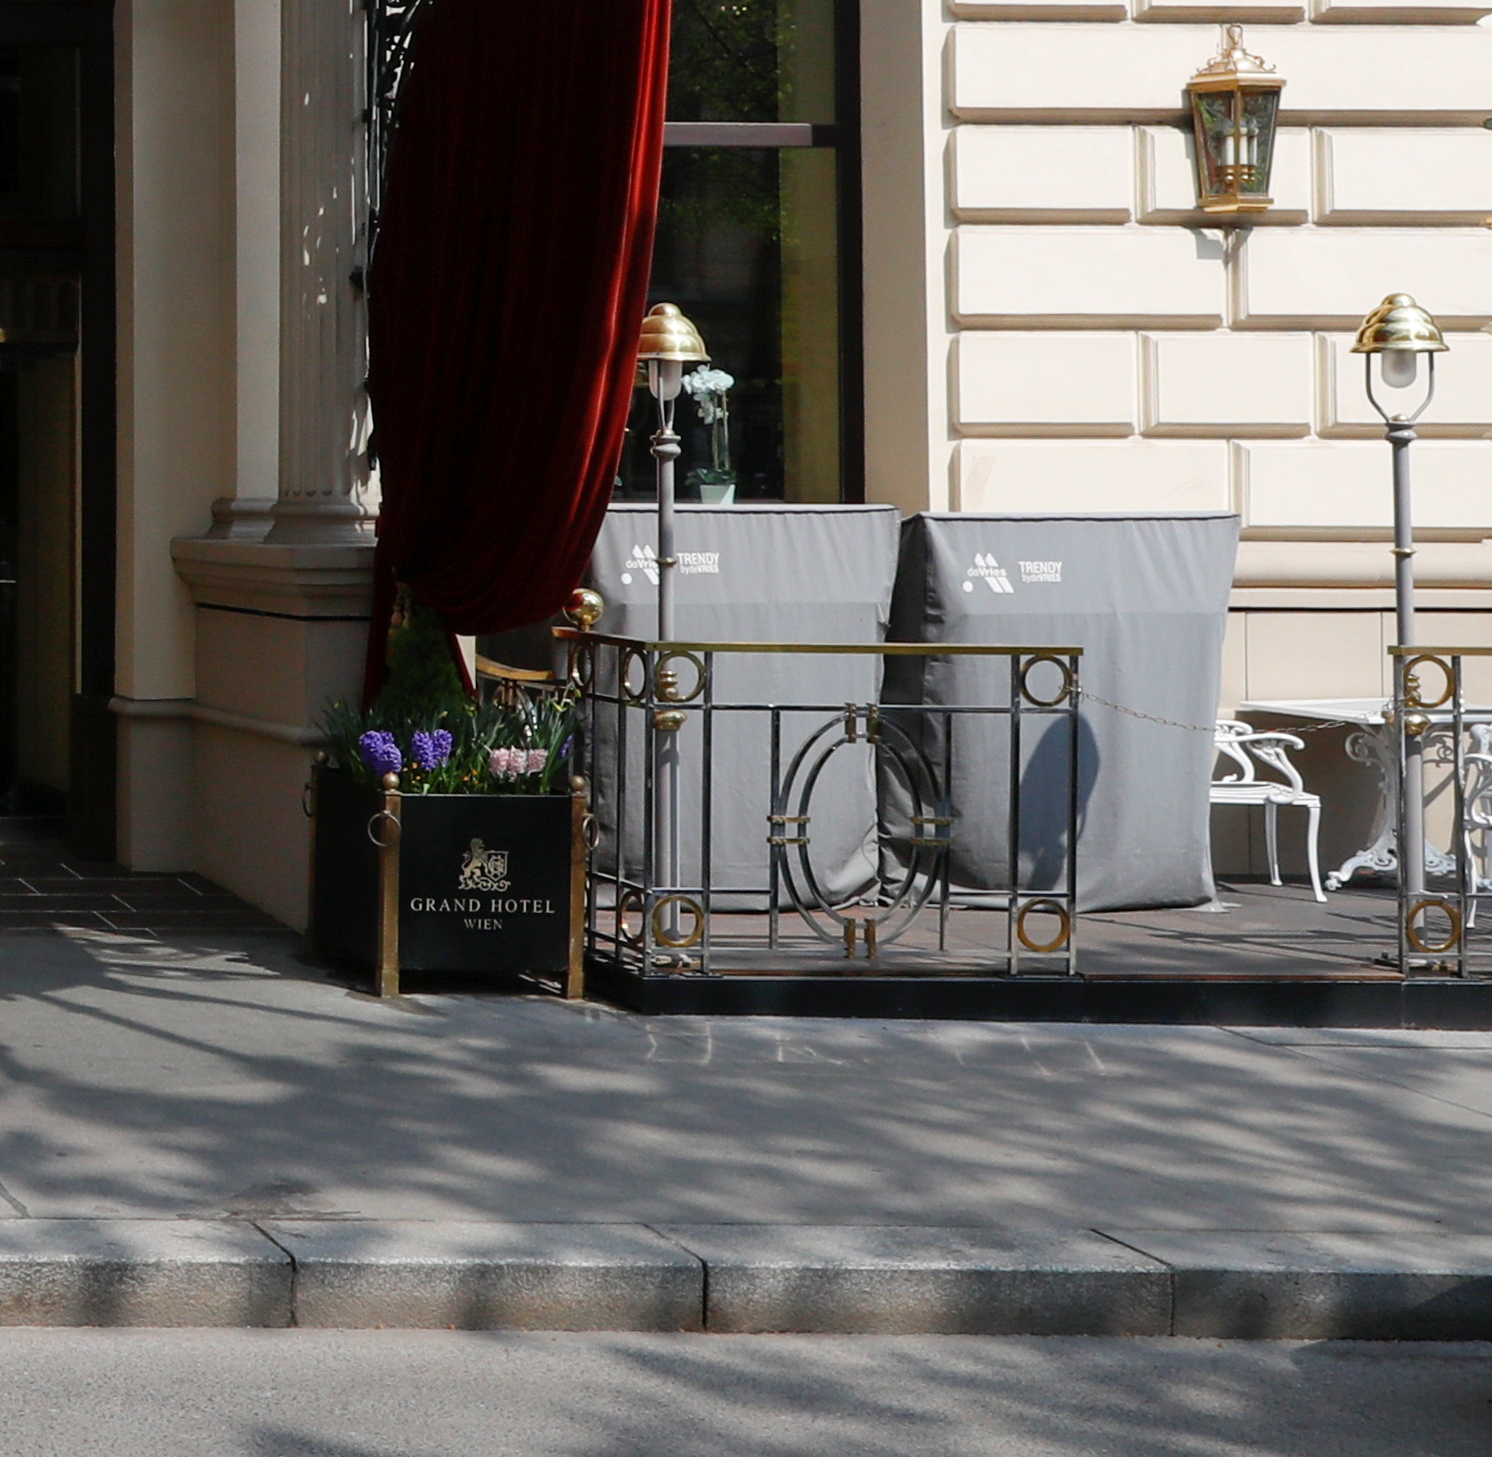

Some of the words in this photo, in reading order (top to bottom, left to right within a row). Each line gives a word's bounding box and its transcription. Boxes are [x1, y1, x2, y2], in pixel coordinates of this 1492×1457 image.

[625, 558, 660, 569] deVrie
[676, 552, 720, 565] TRENDY
[967, 567, 1007, 577] deVries
[1018, 561, 1062, 573] TRENDY
[410, 897, 481, 913] GRAND
[491, 898, 555, 914] HOTEL
[464, 918, 503, 930] WIEN
